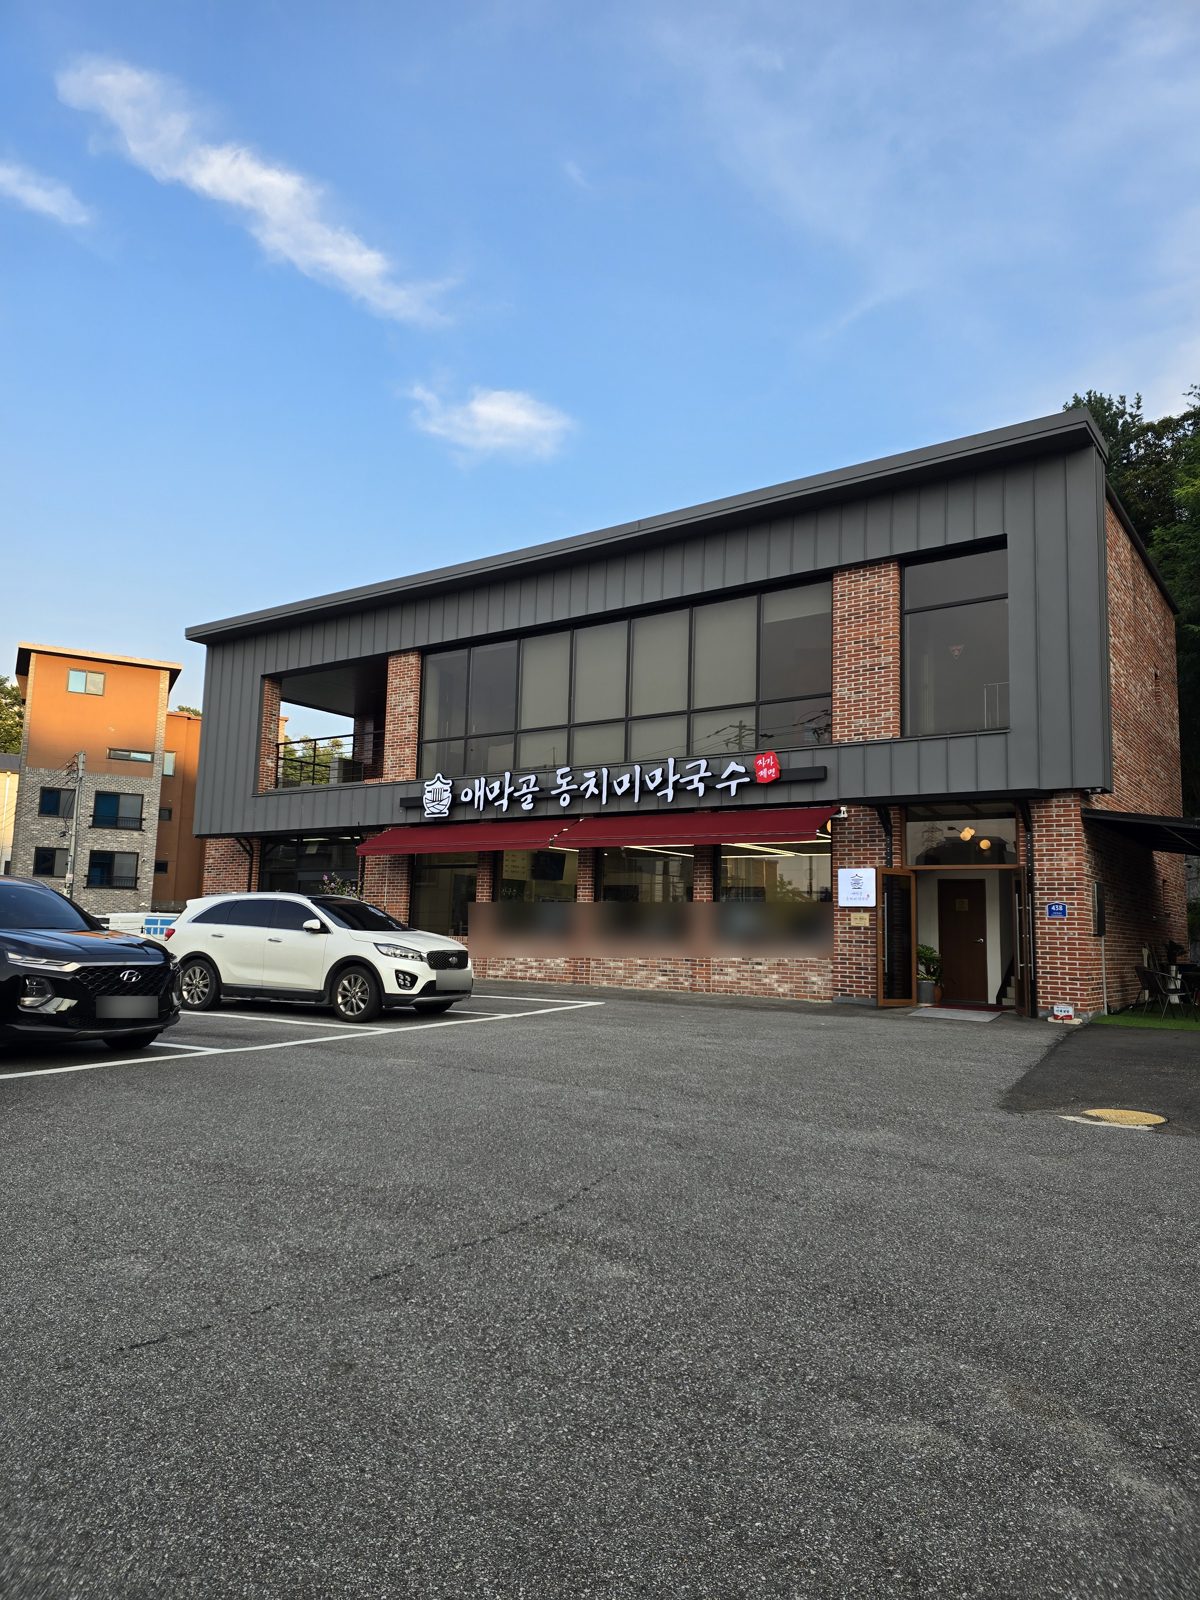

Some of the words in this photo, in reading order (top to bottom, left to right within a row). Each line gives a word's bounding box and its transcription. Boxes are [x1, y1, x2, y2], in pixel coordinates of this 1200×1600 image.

[756, 755, 775, 767] 자가
[758, 767, 776, 779] 제면
[460, 771, 540, 812] 애막골
[550, 757, 751, 807] 동치미막국수
